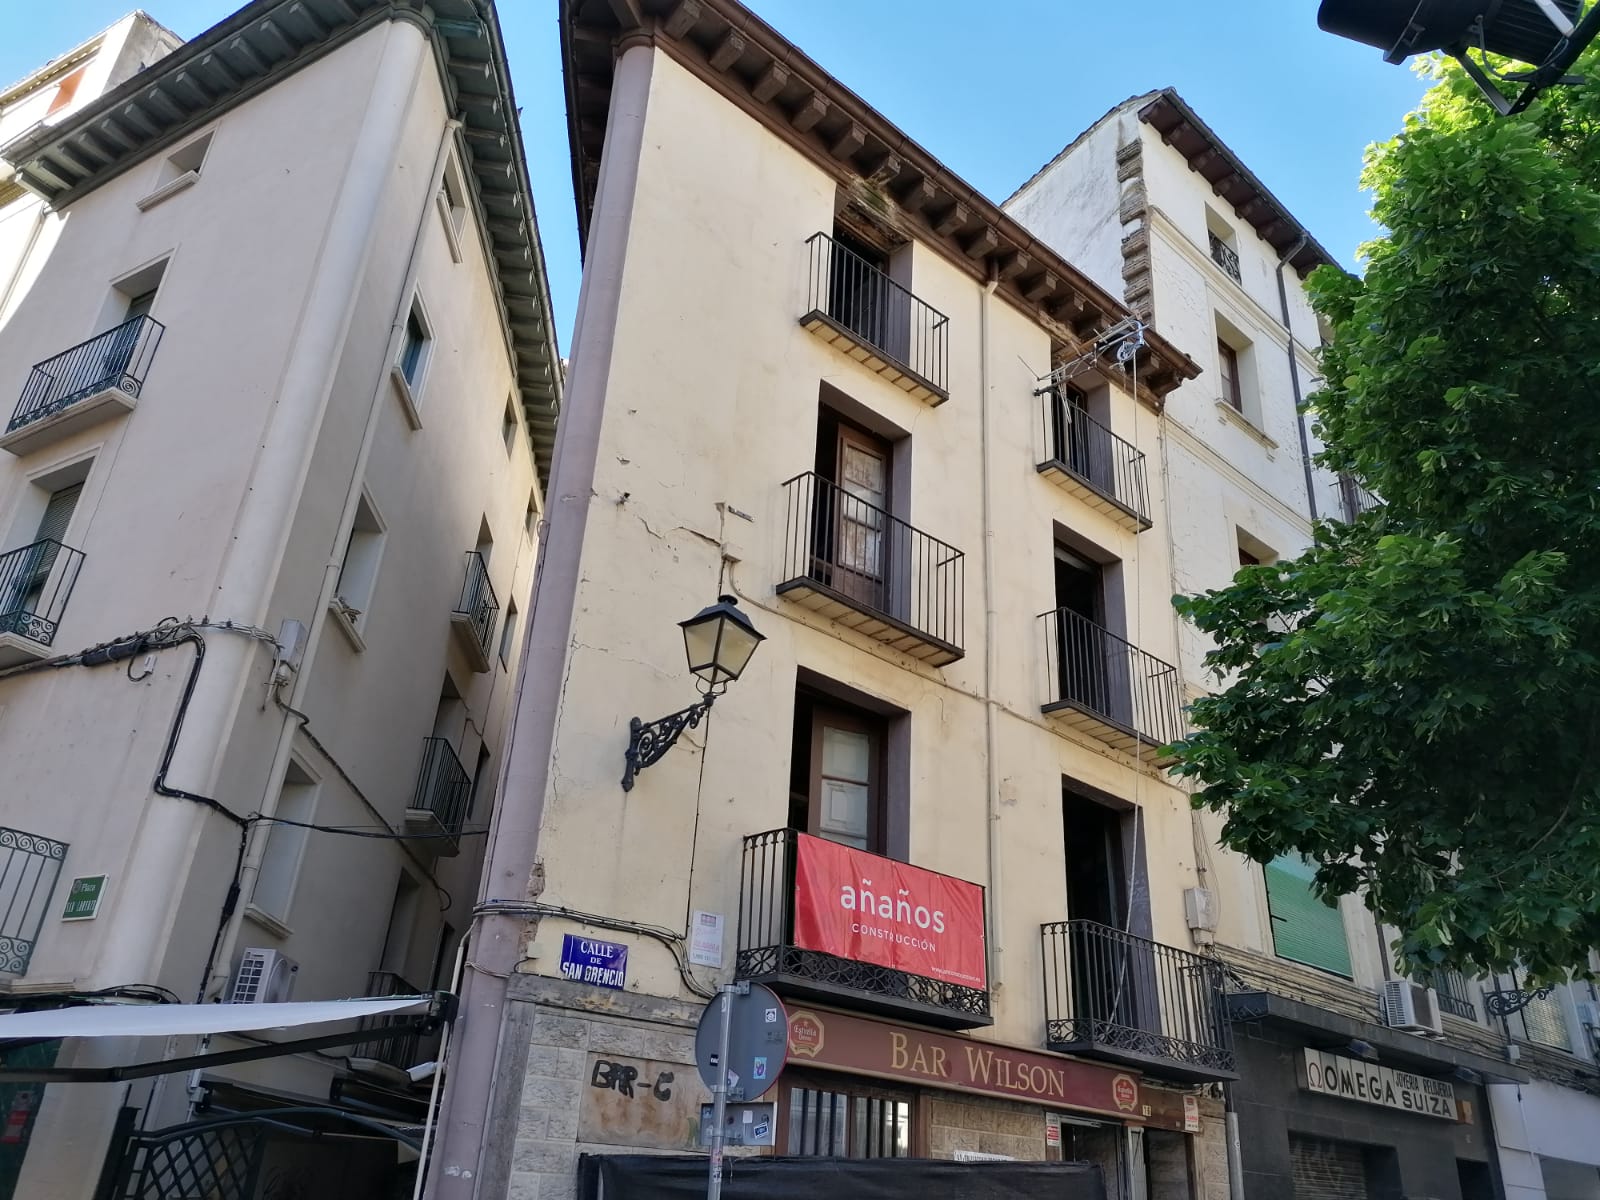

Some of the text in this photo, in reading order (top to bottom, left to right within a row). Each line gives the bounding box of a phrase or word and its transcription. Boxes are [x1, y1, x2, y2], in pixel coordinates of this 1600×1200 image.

[840, 878, 945, 933] añaños
[580, 941, 614, 958] CALLE
[851, 923, 936, 952] CONSTRUCCIÓN
[590, 956, 602, 964] DE
[562, 961, 624, 987] SAN ORENCIO
[890, 1031, 1065, 1097] BAR WILSON
[1324, 1065, 1396, 1105] OMEGA
[1395, 1072, 1419, 1092] JOYERIA
[1401, 1090, 1452, 1117] SUIZA
